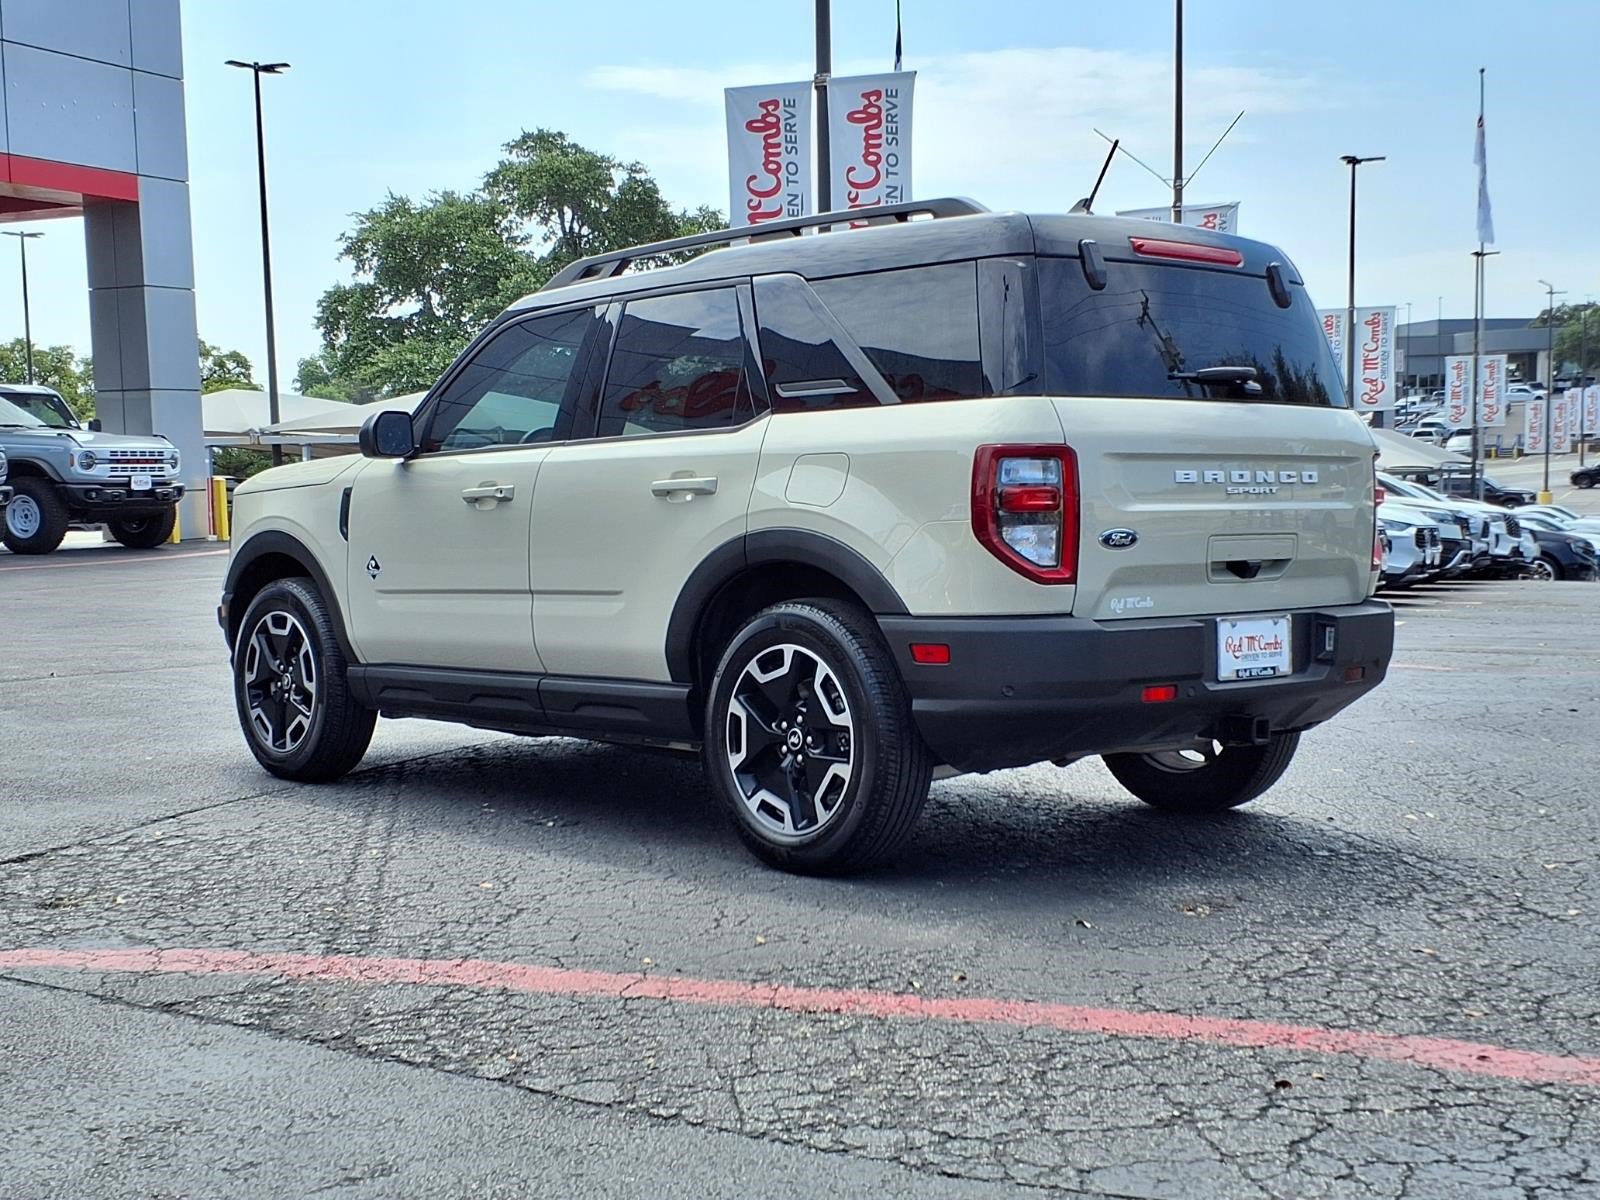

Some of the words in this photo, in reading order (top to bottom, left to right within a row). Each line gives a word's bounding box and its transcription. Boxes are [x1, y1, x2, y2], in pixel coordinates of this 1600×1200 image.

[783, 98, 798, 155] SERVE
[885, 88, 898, 146] SERVE
[786, 161, 799, 187] TO
[885, 153, 899, 180] TO
[1362, 312, 1381, 375] McCombs
[1380, 338, 1388, 350] TO
[1380, 350, 1389, 379] DRIVEN
[1361, 378, 1385, 405] Red
[1451, 361, 1463, 402] McCombs
[1483, 360, 1496, 401] McCombs
[1449, 405, 1466, 423] Red
[1482, 404, 1499, 422] Red
[1175, 470, 1318, 483] BRONCO
[1226, 486, 1279, 494] SPORT
[1109, 532, 1132, 545] Ford
[1225, 636, 1243, 659] Red
[1244, 634, 1283, 651] McCombs
